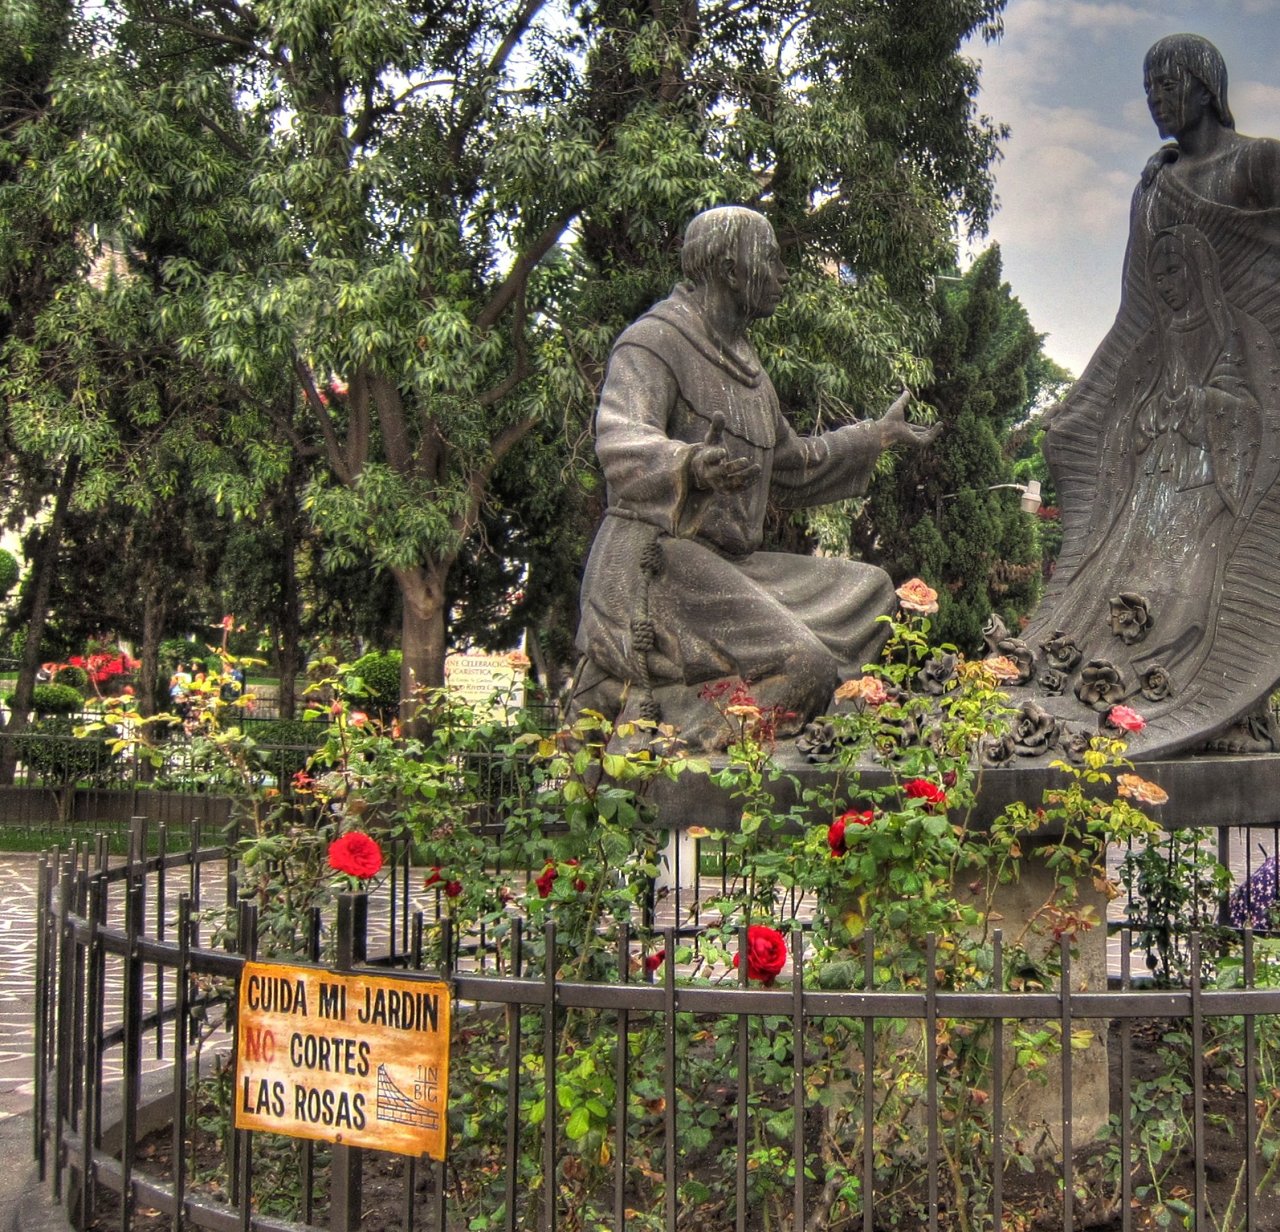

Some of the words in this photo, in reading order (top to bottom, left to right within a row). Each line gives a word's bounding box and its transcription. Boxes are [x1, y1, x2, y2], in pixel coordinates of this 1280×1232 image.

[461, 660, 507, 668] CELEBRACIÓ
[248, 975, 307, 1016] CUIDA
[319, 983, 346, 1021] MI
[358, 987, 439, 1032] JARDIN
[245, 1026, 275, 1063] NO
[290, 1033, 371, 1077] CORTES
[243, 1076, 285, 1117] LAS
[294, 1084, 366, 1131] ROSAS
